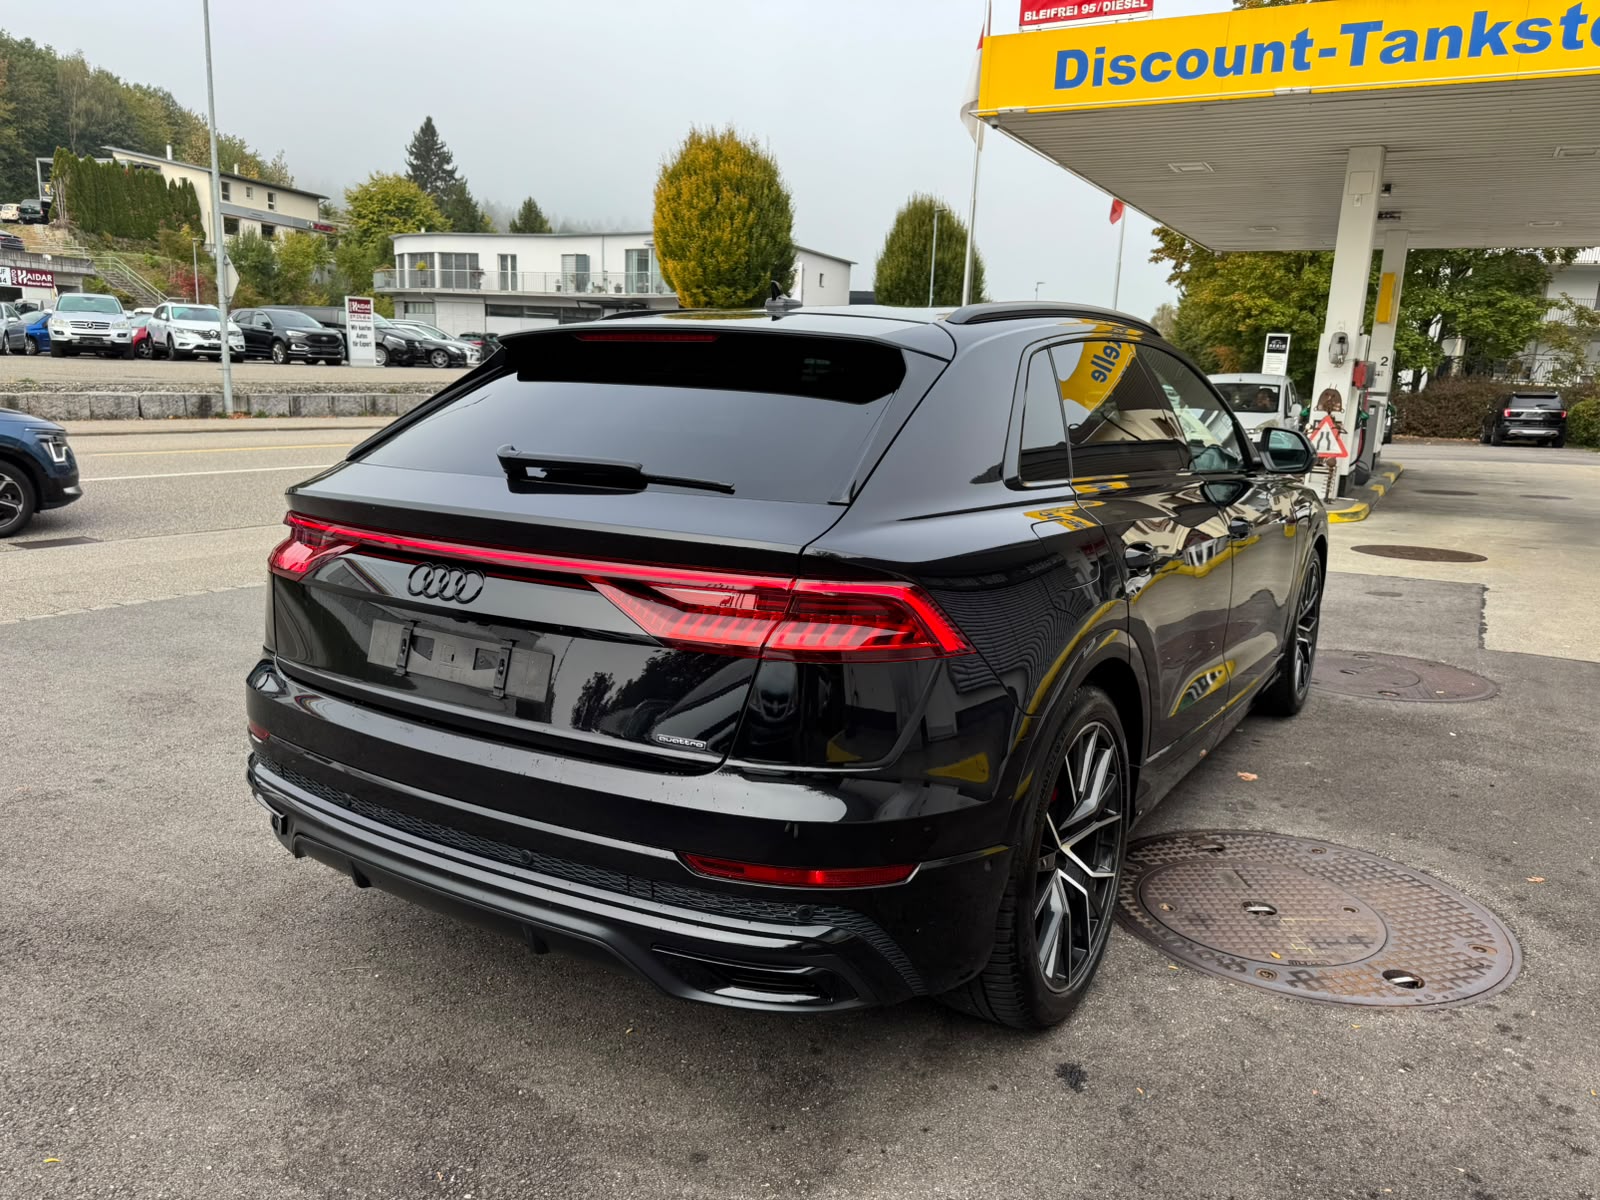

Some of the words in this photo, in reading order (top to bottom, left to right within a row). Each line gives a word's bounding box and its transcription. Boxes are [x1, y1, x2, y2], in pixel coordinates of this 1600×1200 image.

[1023, 5, 1078, 22] BLEIFREI
[1055, 2, 1600, 89] Discount-Tankst
[1380, 356, 1389, 367] 2
[658, 736, 703, 747] quattro
